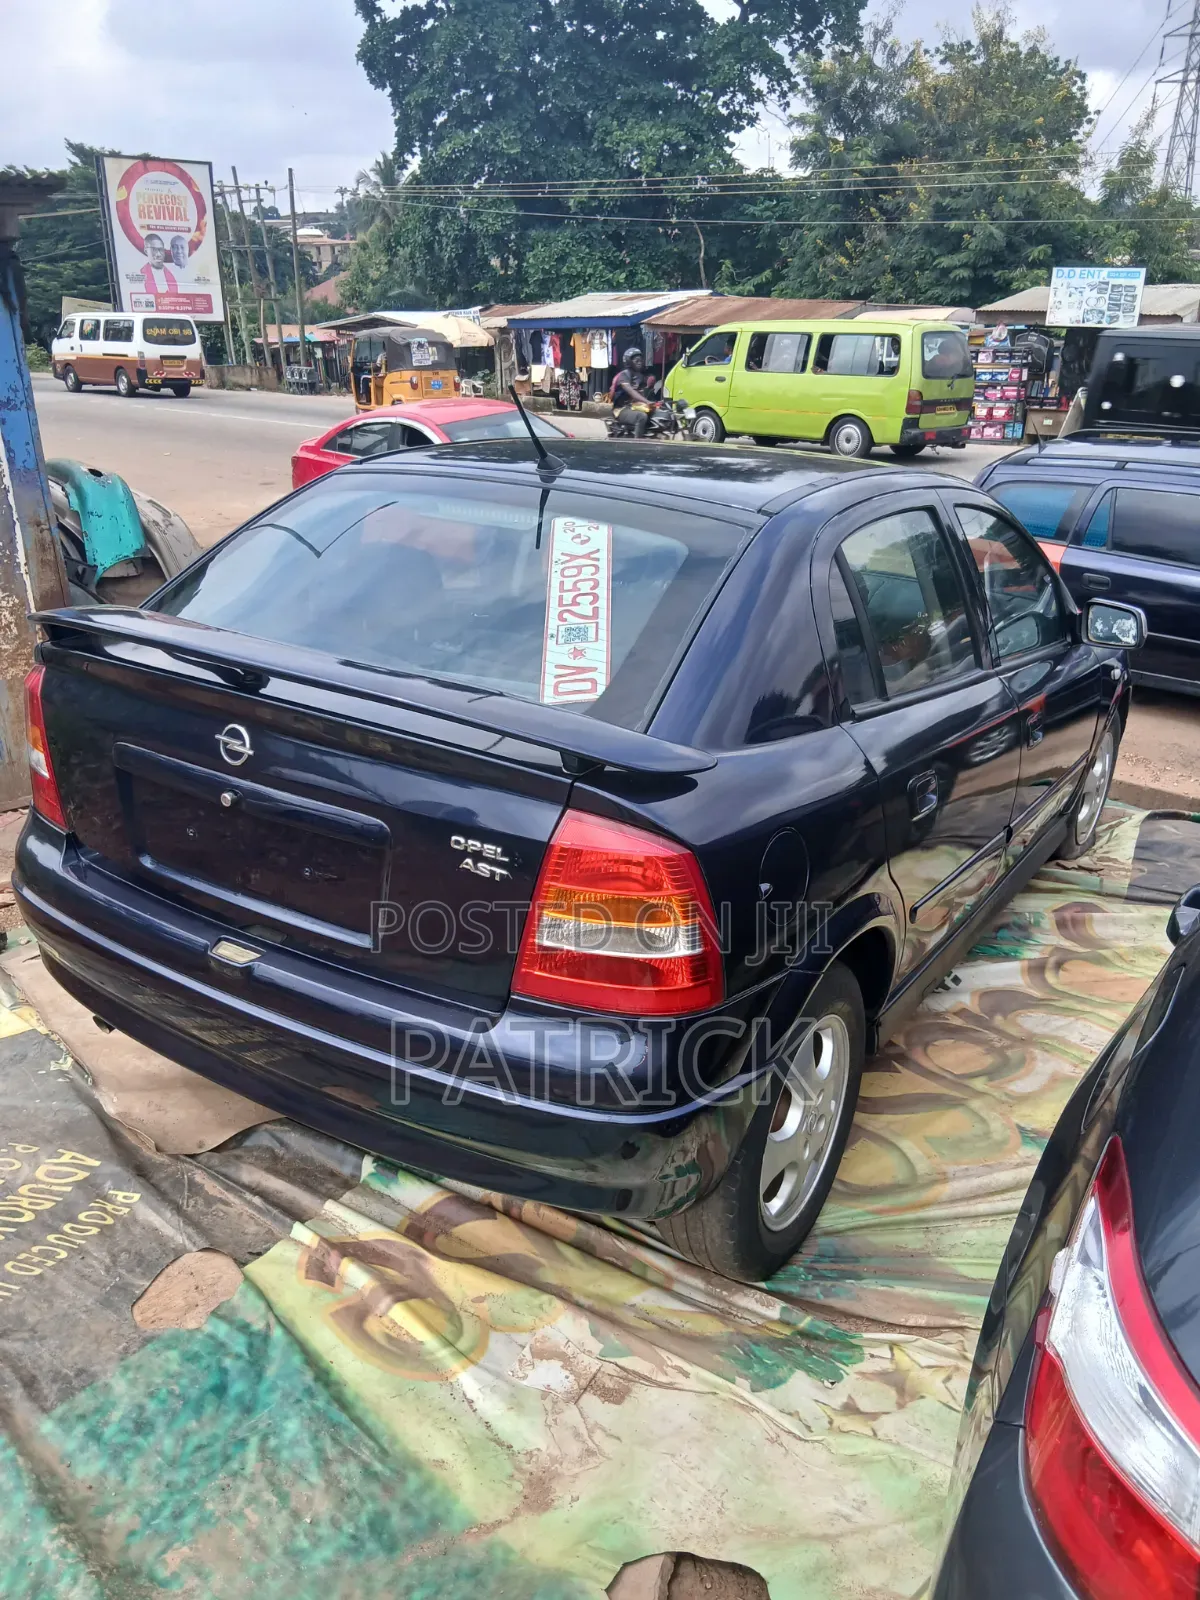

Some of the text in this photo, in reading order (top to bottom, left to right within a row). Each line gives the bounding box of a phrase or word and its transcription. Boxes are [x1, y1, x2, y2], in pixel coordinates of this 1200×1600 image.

[136, 192, 188, 207] PENTECOST
[138, 204, 190, 222] REVIVAL
[552, 548, 600, 697] DV 2559X
[450, 835, 510, 862] OPEL
[459, 858, 510, 882] AST
[4, 1190, 142, 1276] PRODUCED
